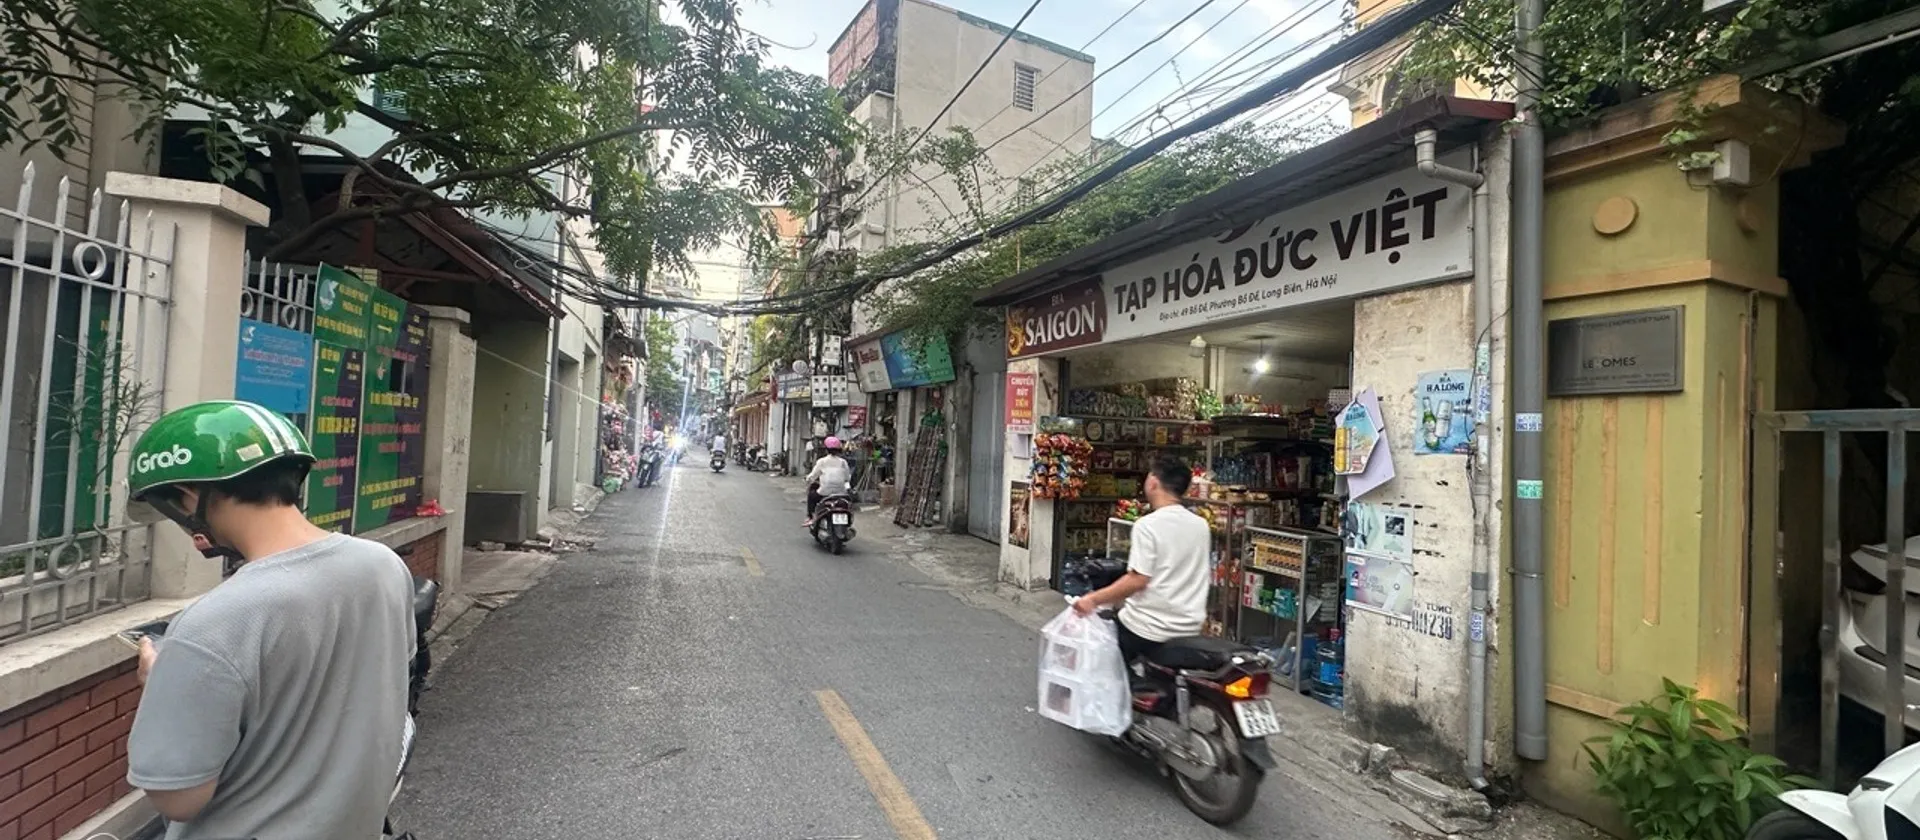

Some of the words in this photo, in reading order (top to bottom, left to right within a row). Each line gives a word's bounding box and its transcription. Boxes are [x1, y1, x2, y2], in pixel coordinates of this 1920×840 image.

[1113, 276, 1157, 322] TẠP
[1162, 252, 1226, 304] HÓA
[1233, 225, 1319, 287] ĐỨC
[1329, 187, 1448, 264] VIỆT
[1180, 307, 1189, 317] 49
[1209, 297, 1237, 312] Phường
[1261, 287, 1282, 301] Long
[1282, 283, 1304, 297] Biên,
[1305, 278, 1319, 291] Hà
[1320, 273, 1338, 290] Nội
[1025, 300, 1096, 347] SAIGON
[136, 443, 192, 474] Grab
